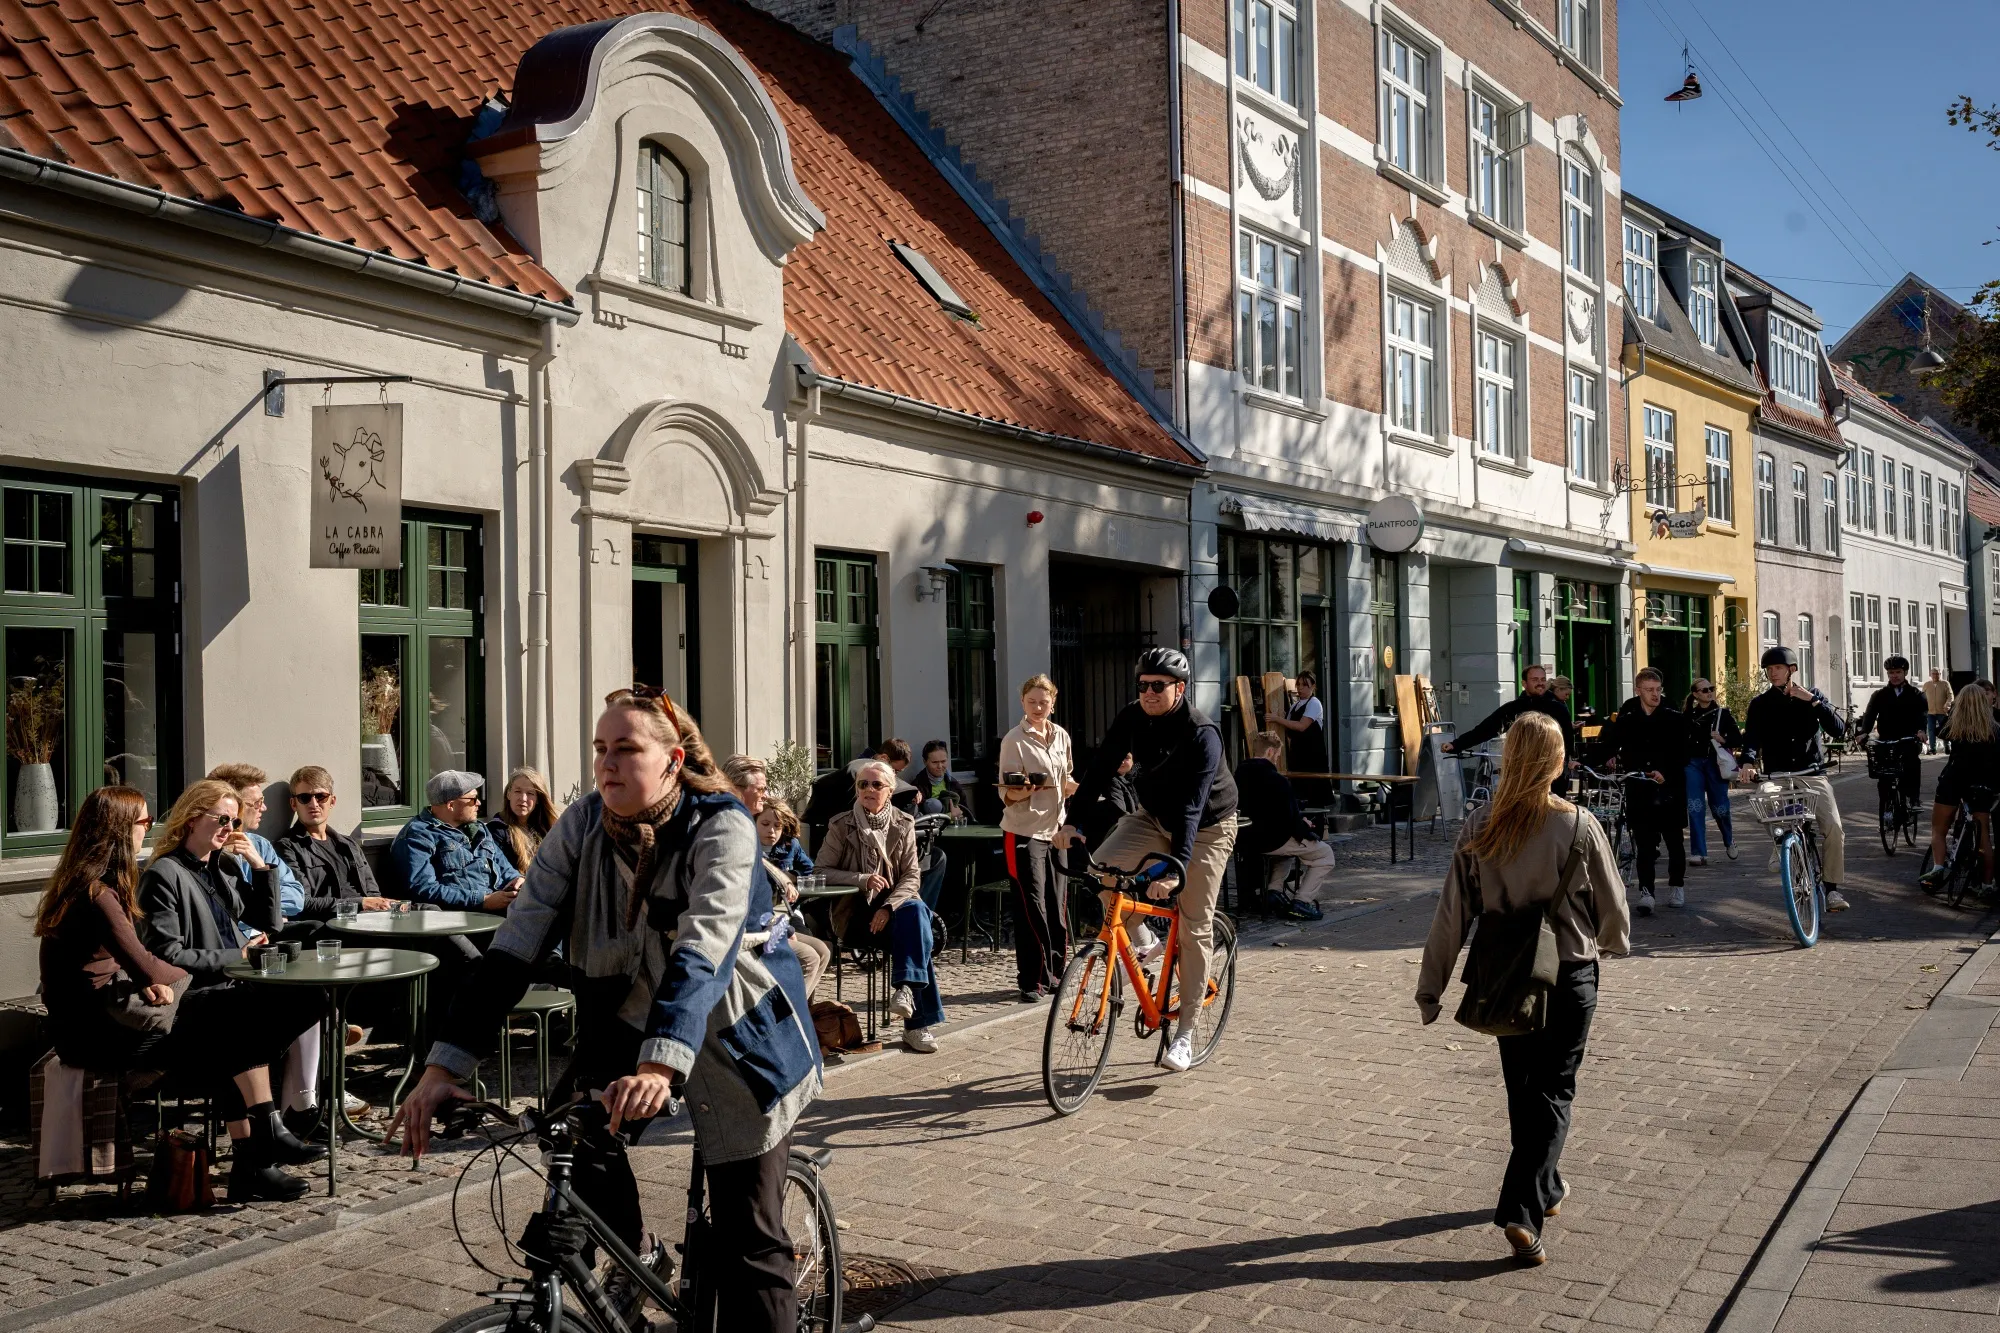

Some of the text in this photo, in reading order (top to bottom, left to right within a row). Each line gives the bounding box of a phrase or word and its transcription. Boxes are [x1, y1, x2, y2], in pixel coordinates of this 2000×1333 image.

[1369, 519, 1419, 529] PLANTFOOD
[325, 525, 384, 539] LA CABRA
[329, 542, 381, 560] Coffee Roasters
